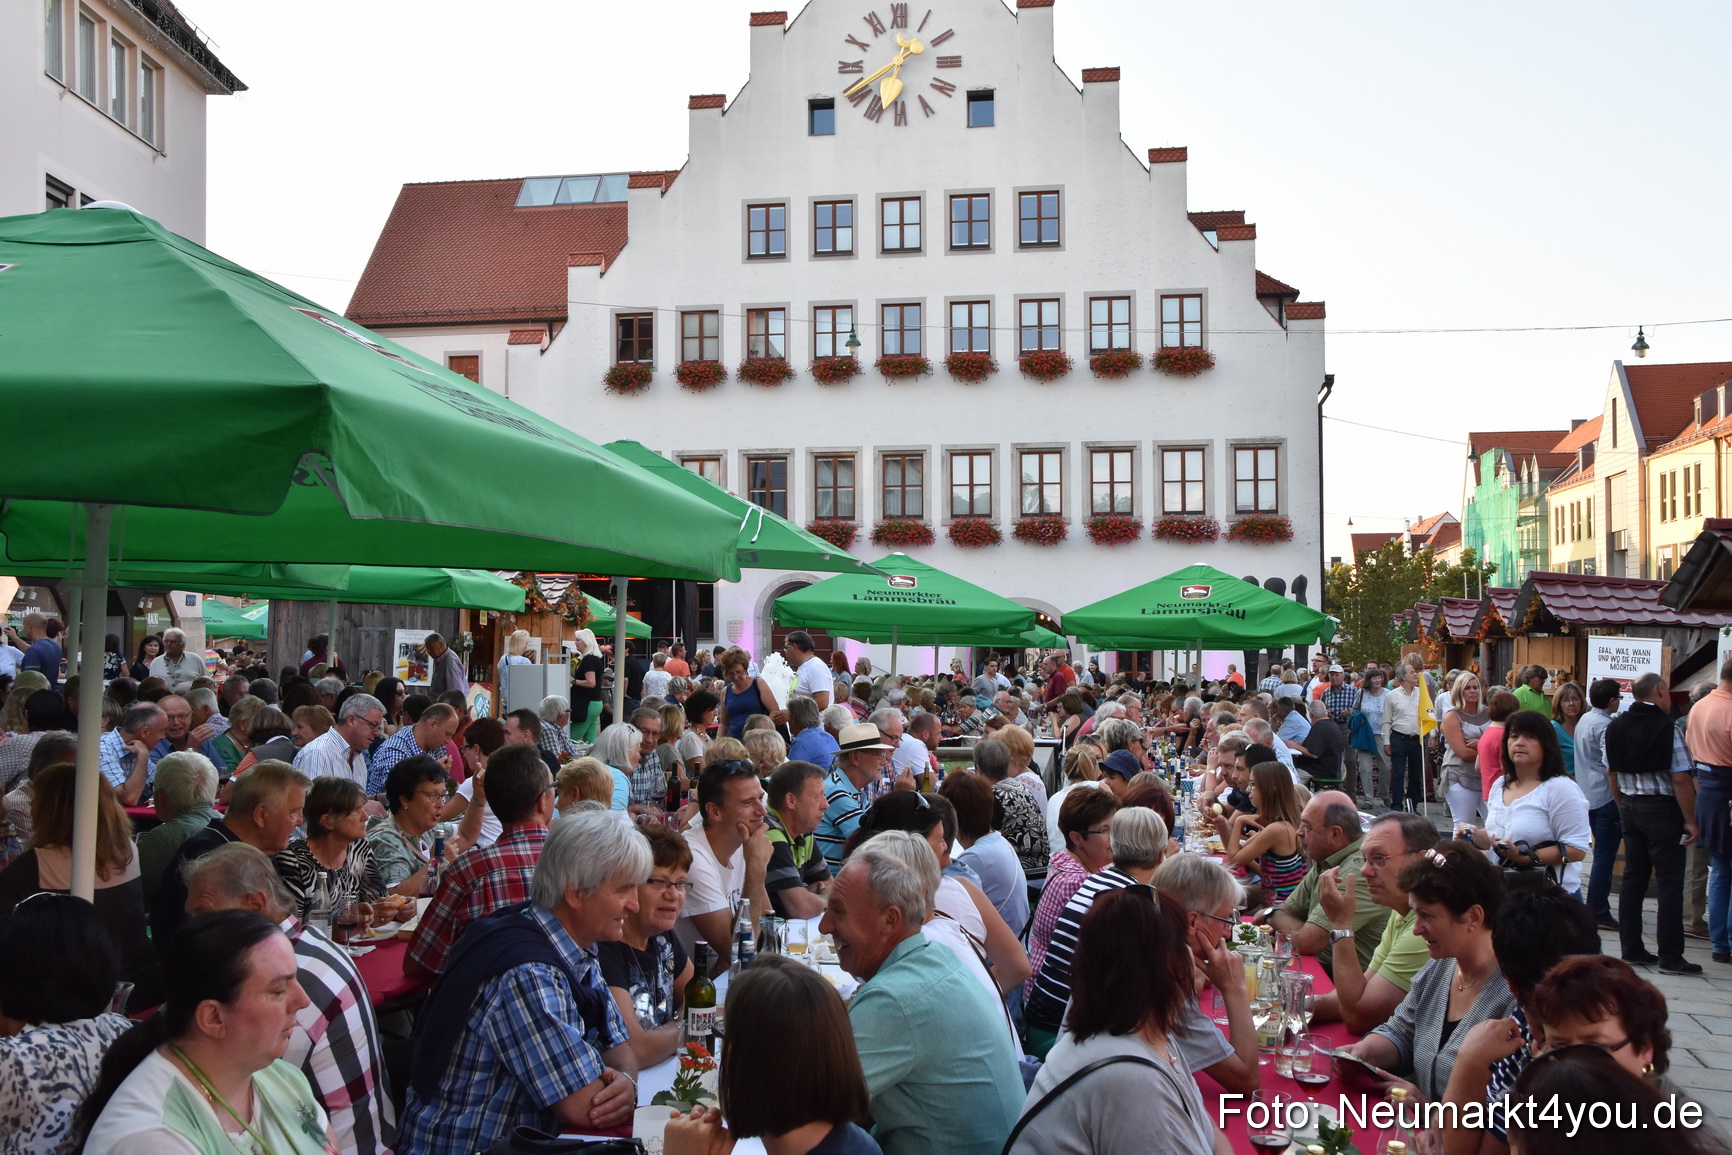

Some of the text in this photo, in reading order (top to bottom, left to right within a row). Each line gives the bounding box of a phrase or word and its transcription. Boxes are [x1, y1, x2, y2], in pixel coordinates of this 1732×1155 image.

[890, 2, 907, 29] XII
[863, 10, 886, 38] XI
[844, 33, 870, 52] X
[930, 28, 955, 48] II
[936, 55, 962, 69] III
[853, 594, 956, 605] Lammsbräu
[867, 589, 942, 598] Neumarkter
[1610, 655, 1620, 663] WO
[1631, 656, 1650, 664] FEIERN
